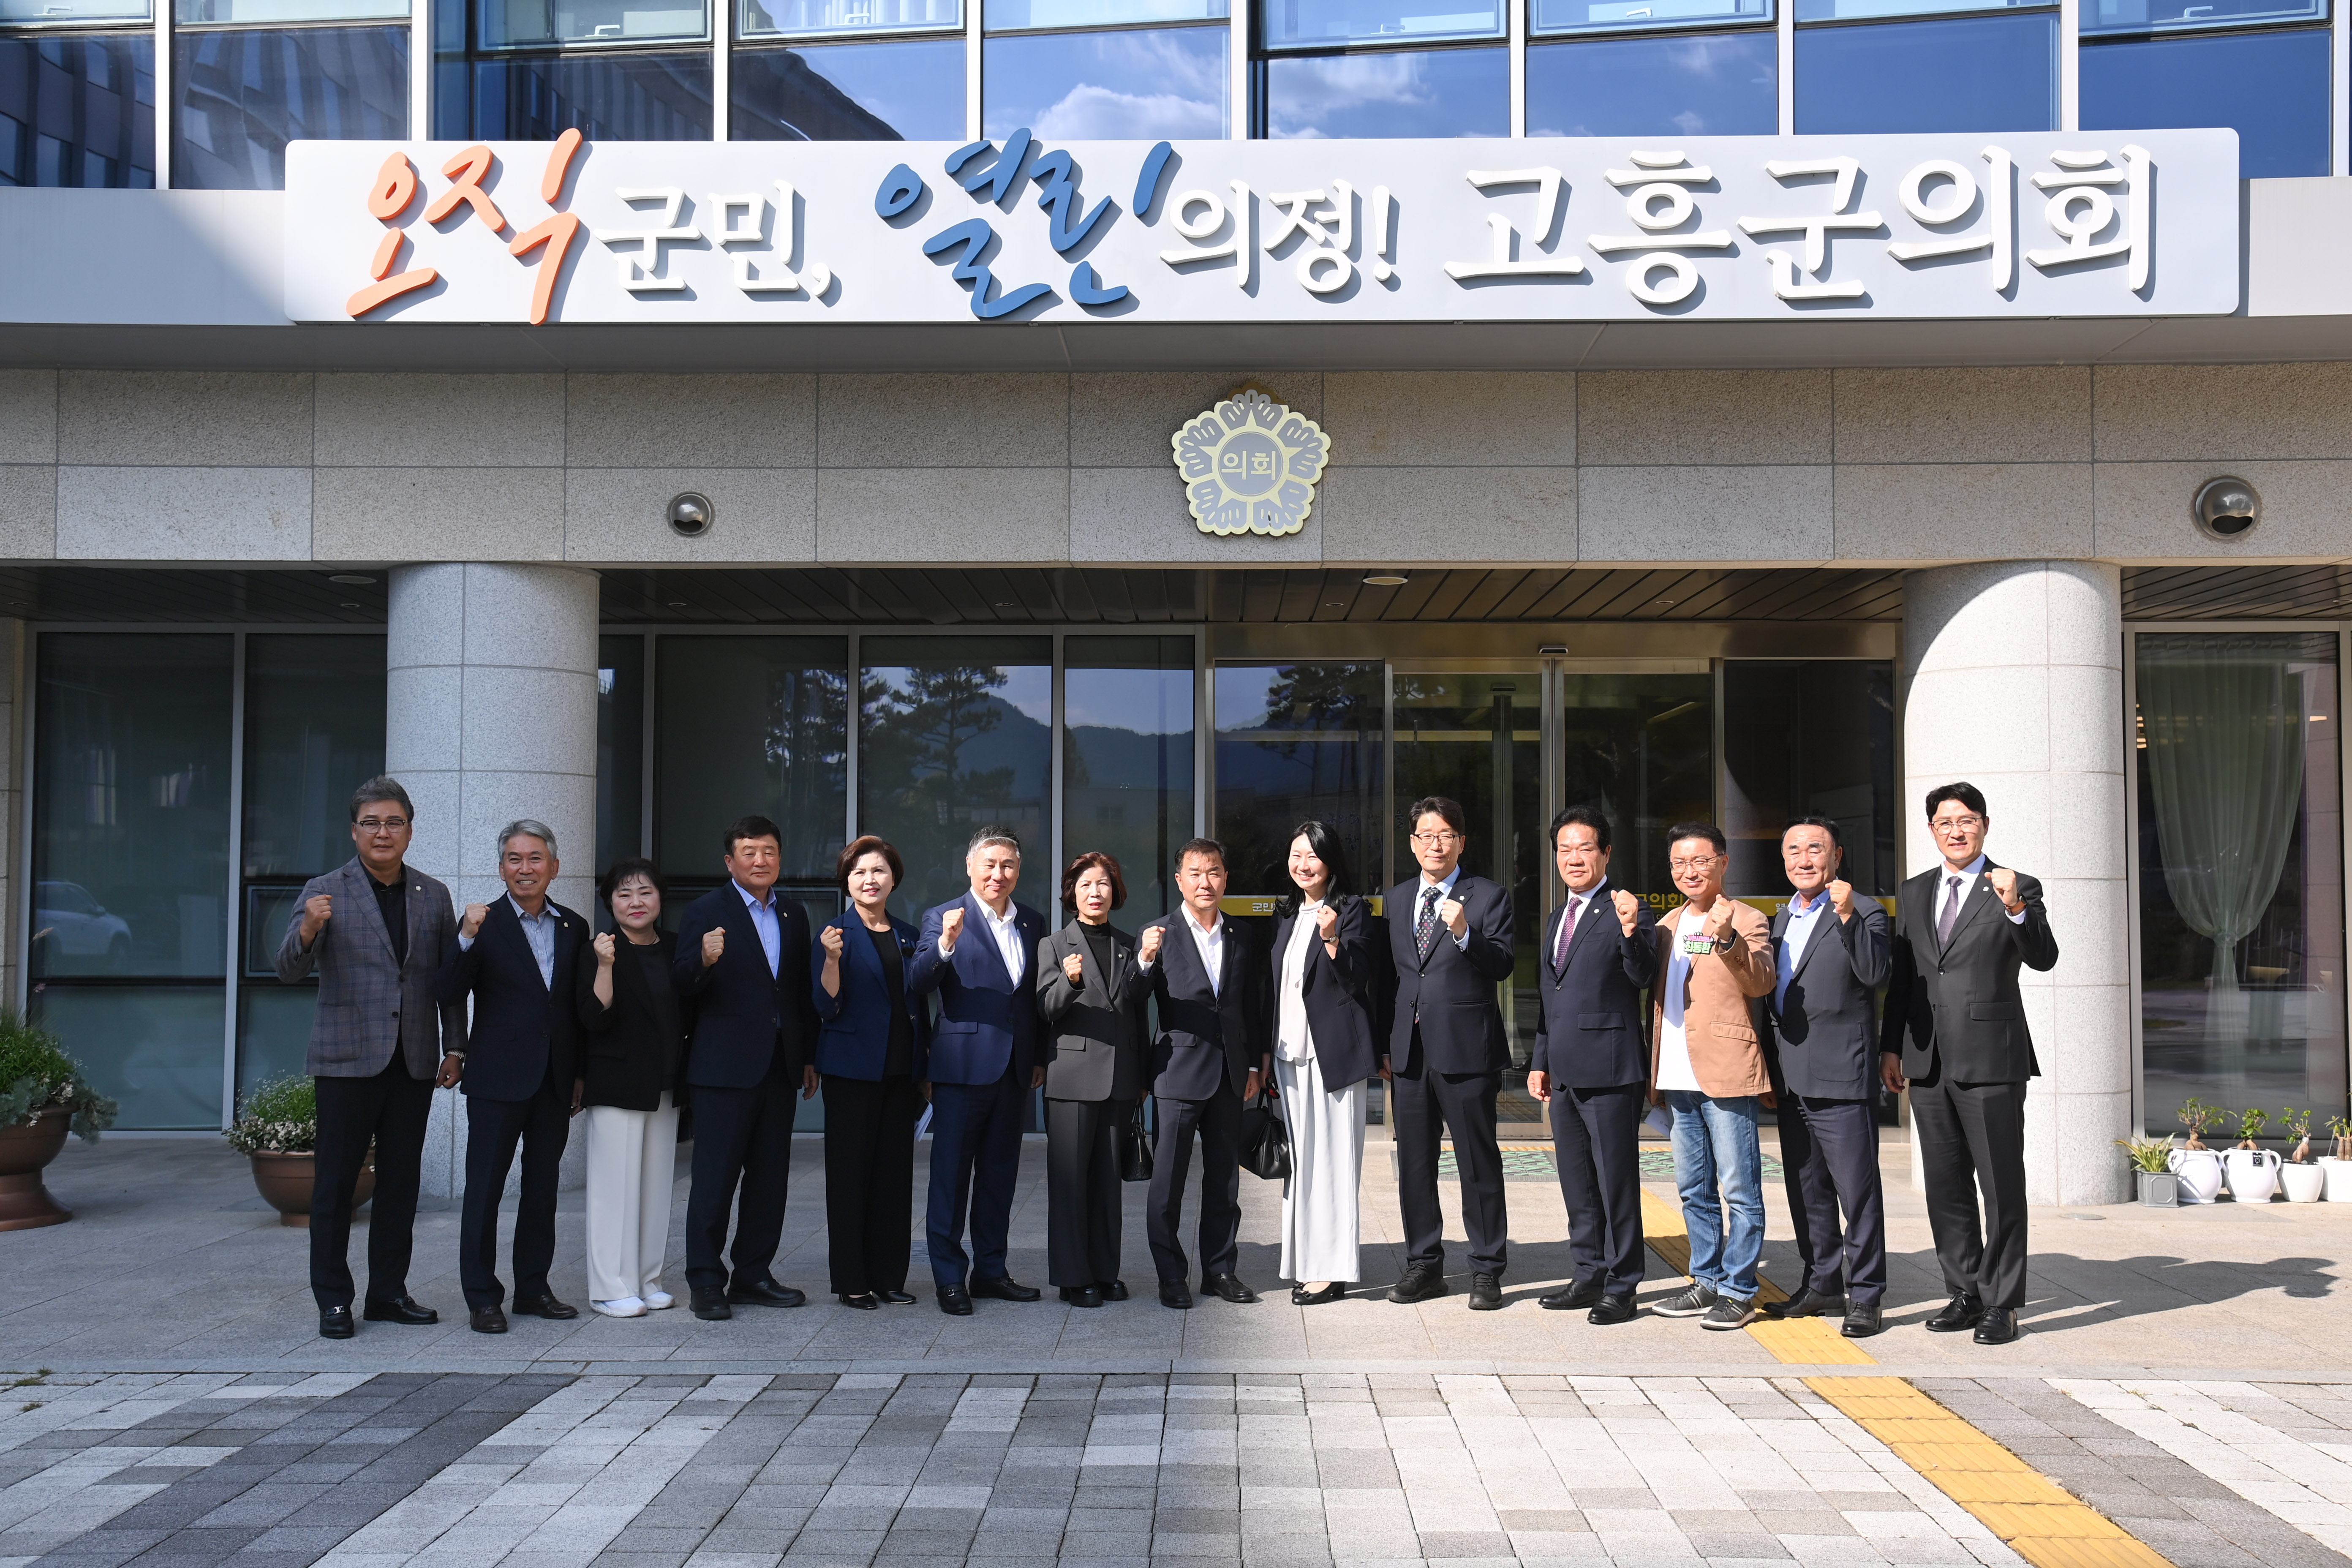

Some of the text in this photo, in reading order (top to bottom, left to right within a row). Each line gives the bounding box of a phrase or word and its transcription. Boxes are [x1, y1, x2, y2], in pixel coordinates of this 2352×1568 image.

[346, 128, 2151, 326] 오직 군민, 열린 의정! 고흥군의회
[1221, 450, 1276, 480] 의회
[1684, 940, 1711, 954] 최동환
